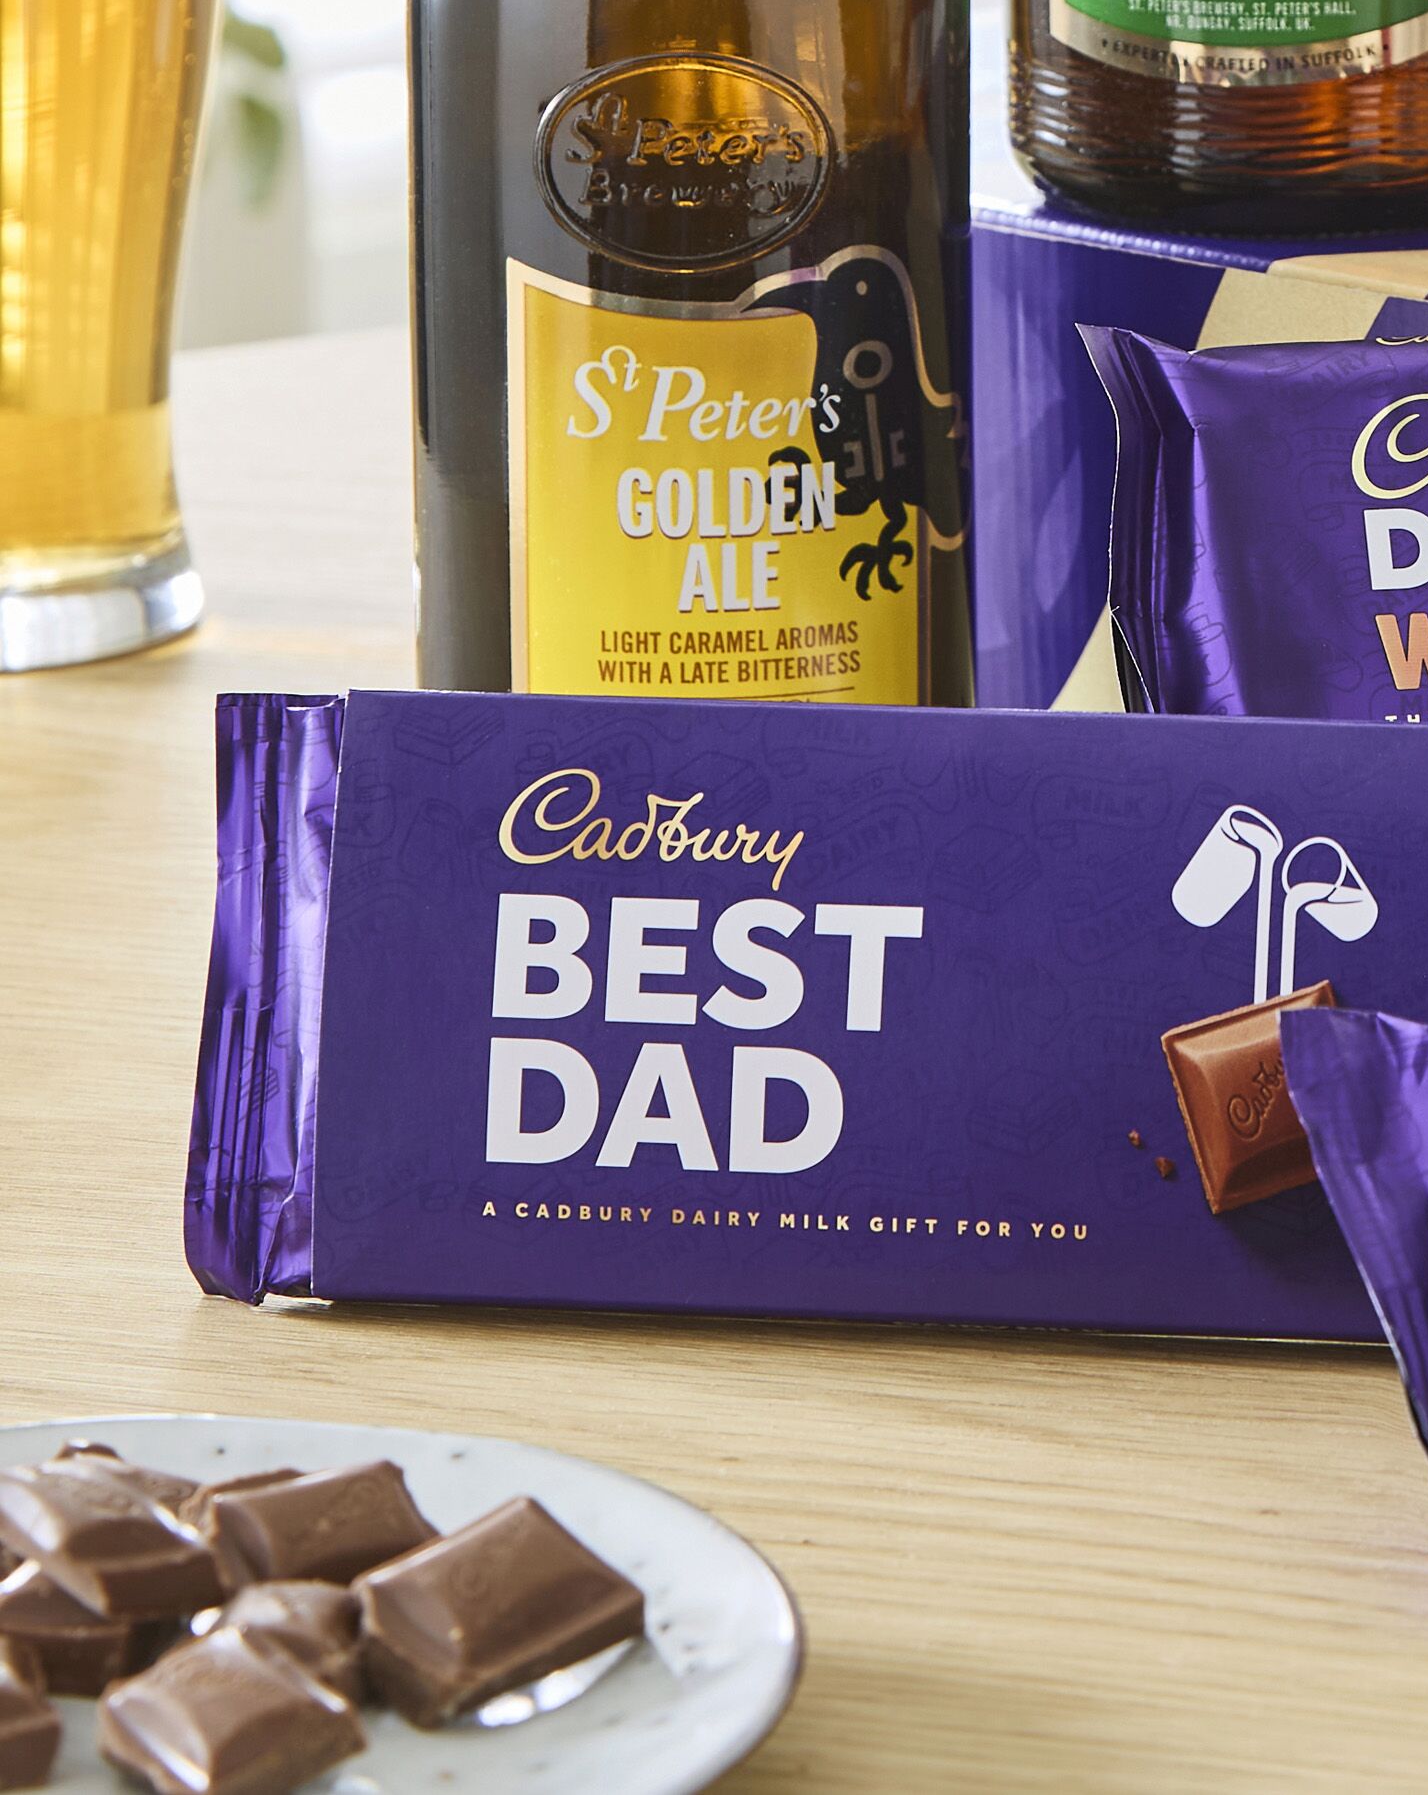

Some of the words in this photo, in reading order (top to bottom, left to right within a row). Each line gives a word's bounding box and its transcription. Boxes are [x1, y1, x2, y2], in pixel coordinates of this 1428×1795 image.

[1275, 57, 1295, 71] IN
[567, 345, 641, 439] St
[638, 365, 841, 442] Peter's
[617, 462, 836, 538] GOLDEN
[677, 541, 781, 611] ALE
[598, 660, 650, 683] WITH
[659, 662, 672, 684] A
[680, 662, 729, 684] LATE
[738, 650, 861, 683] BITTERNESS
[601, 630, 661, 654] LIGHT
[669, 630, 768, 654] CARAMEL
[775, 621, 858, 649] AROMAS
[499, 768, 804, 891] Cadbury
[492, 893, 924, 1032] BEST
[485, 1037, 844, 1174] DAD
[482, 1202, 496, 1216] A
[515, 1203, 652, 1222] CADBURY
[672, 1209, 760, 1226] DAIRY
[780, 1213, 850, 1231] MILK
[870, 1216, 938, 1234] GIFT
[957, 1220, 1010, 1237] FOR
[1031, 1223, 1087, 1240] YOU
